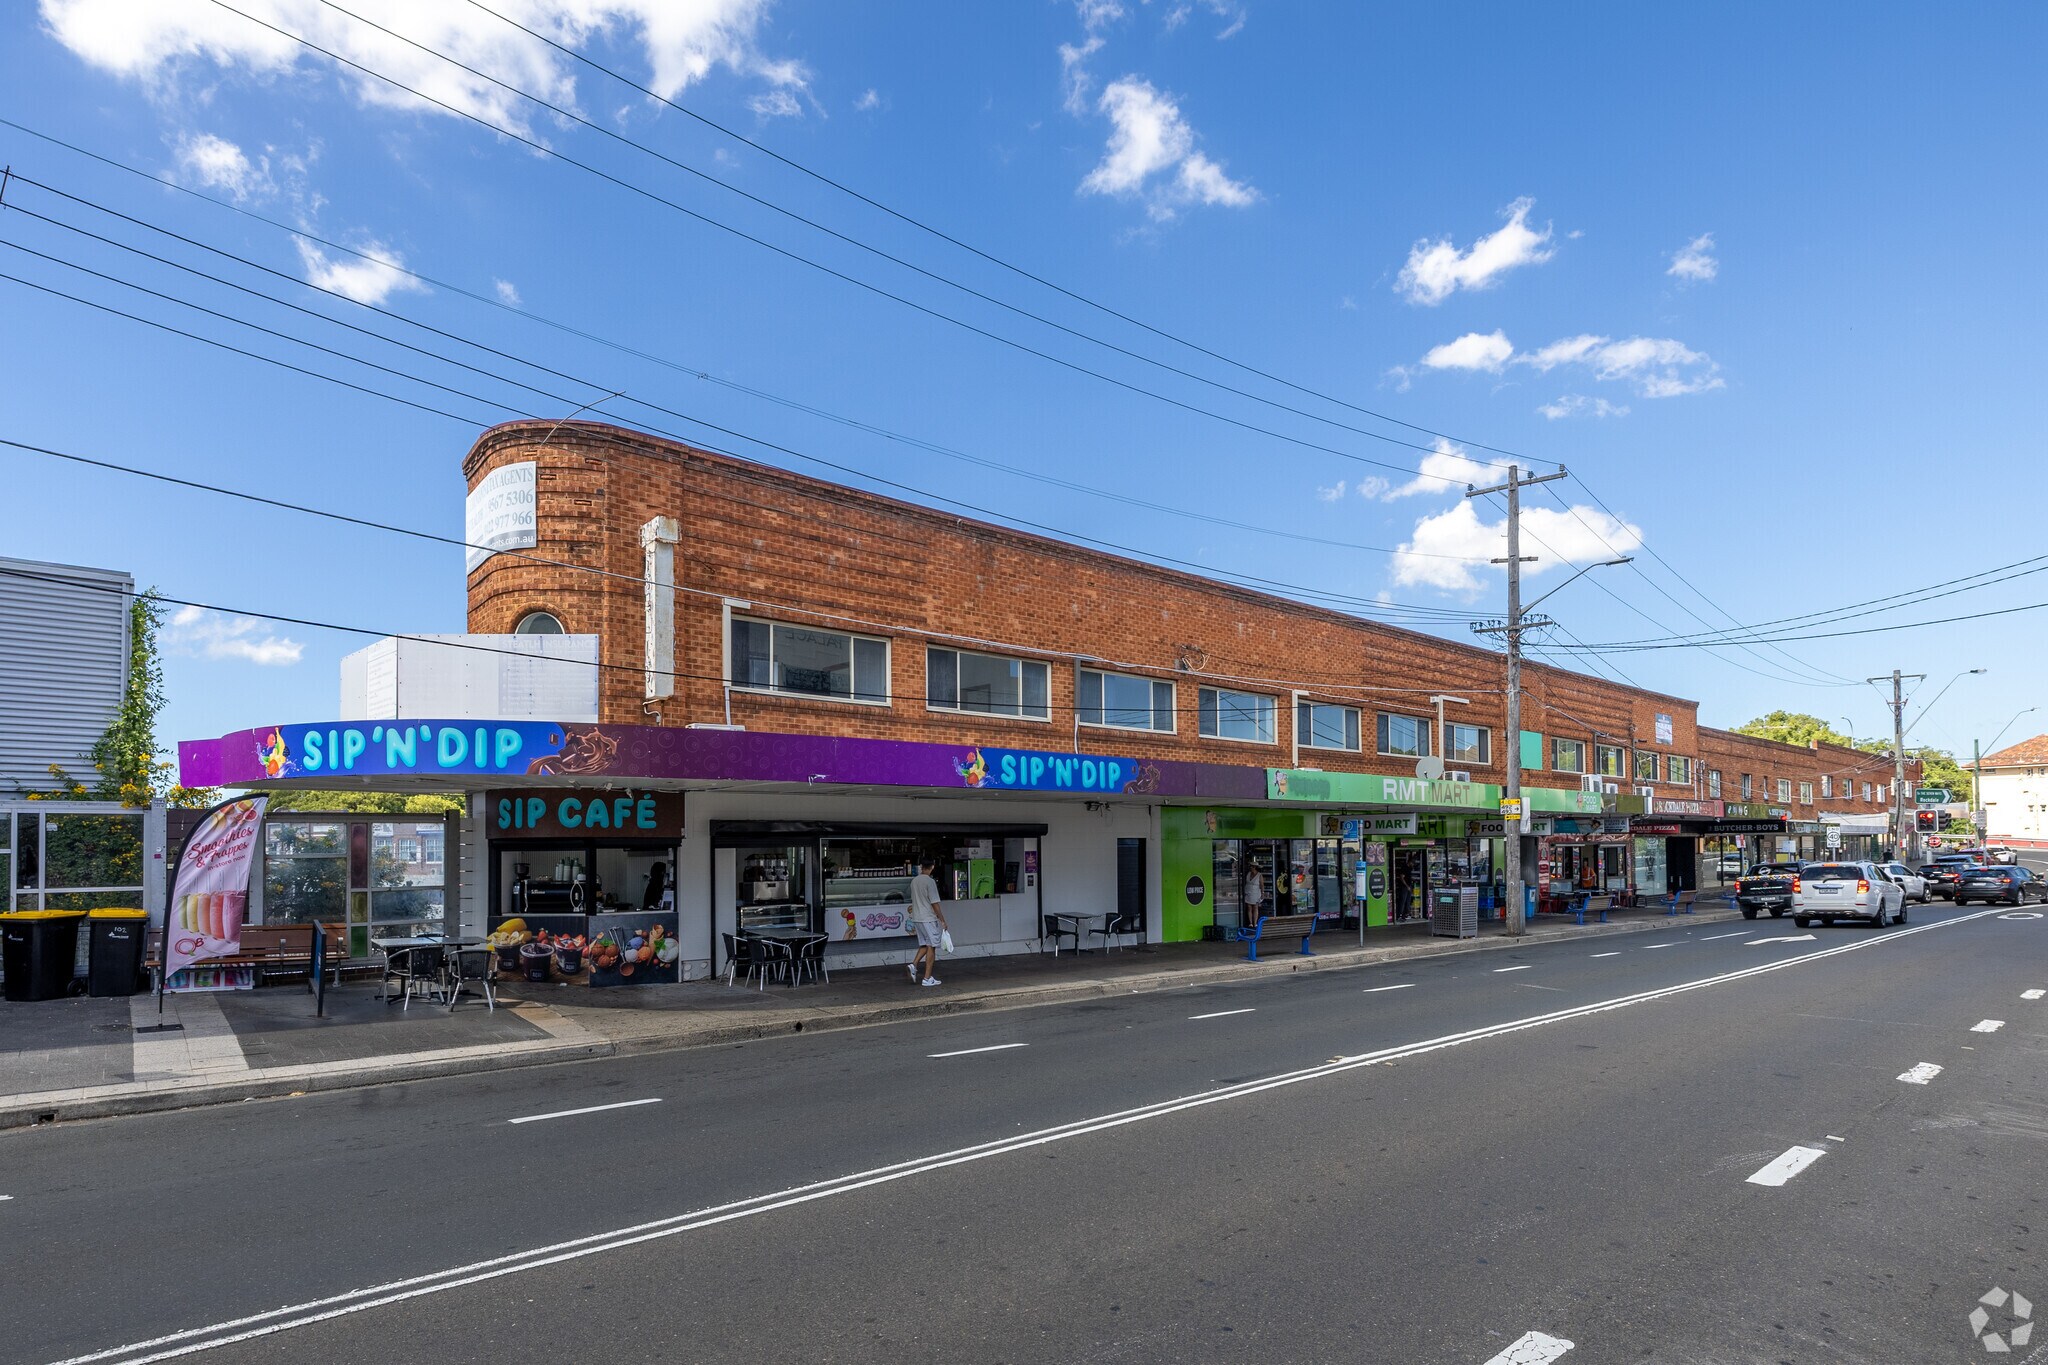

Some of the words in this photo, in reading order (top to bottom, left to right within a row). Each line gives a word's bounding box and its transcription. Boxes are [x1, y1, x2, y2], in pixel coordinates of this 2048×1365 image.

[500, 467, 533, 487] AGENTS
[506, 488, 534, 507] 5306
[494, 514, 510, 530] 977
[512, 511, 533, 526] 966
[543, 639, 596, 649] INSURANCE
[1383, 778, 1429, 801] RMT
[1431, 782, 1470, 804] MART
[498, 798, 547, 829] SIP
[557, 794, 657, 829] CAFÉ
[1375, 819, 1411, 829] MART
[1417, 815, 1446, 835] ART
[1481, 824, 1503, 832] FOO
[188, 827, 254, 860] Smoothies
[1829, 833, 1839, 841] 40
[196, 857, 206, 869] &
[205, 841, 250, 863] Frappes
[233, 855, 246, 864] now
